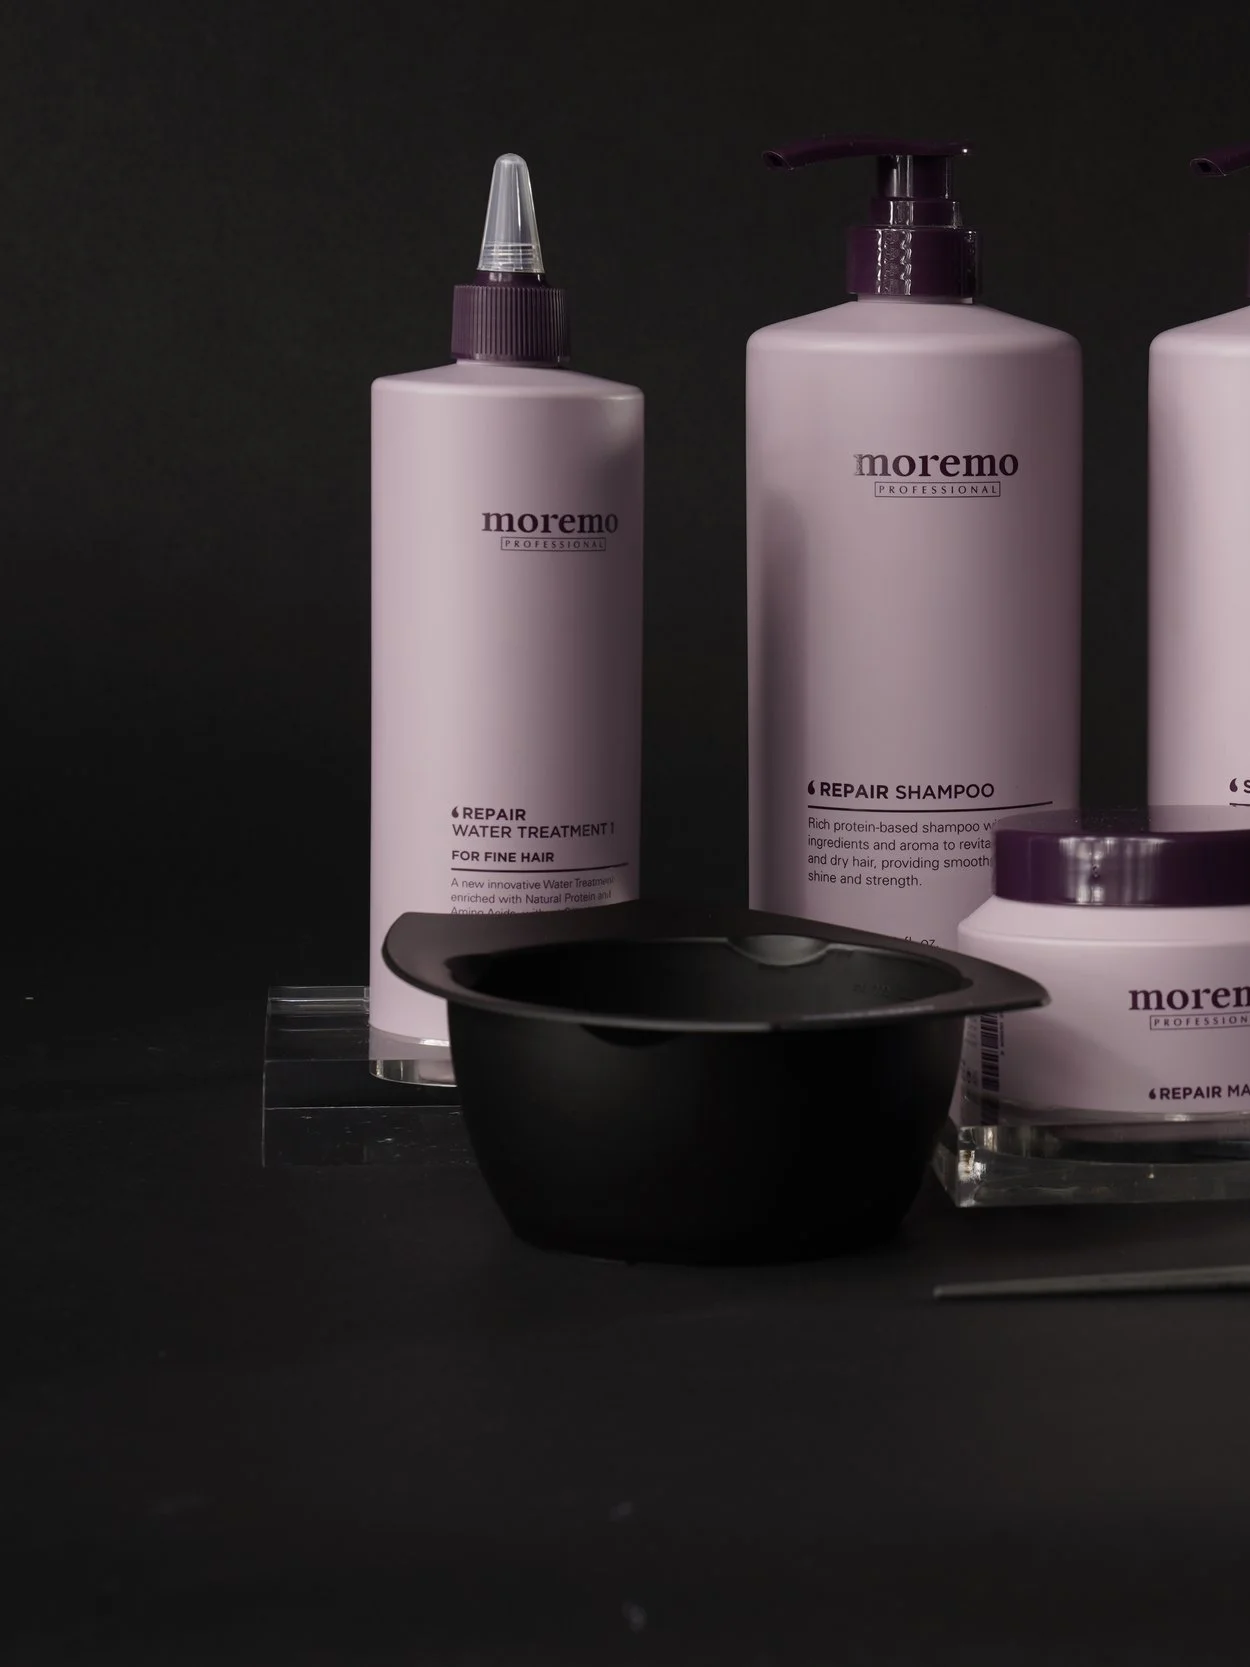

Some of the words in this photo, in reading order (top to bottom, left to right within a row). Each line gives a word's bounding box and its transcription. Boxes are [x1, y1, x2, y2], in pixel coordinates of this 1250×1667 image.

[853, 453, 1018, 477] moremo
[879, 485, 997, 494] PROFESSIONAL
[482, 512, 618, 533] moremo
[506, 540, 603, 548] PROFESSIONAL
[820, 782, 888, 799] REPAIR
[896, 783, 994, 799] SHAMPOO
[463, 807, 526, 821] REPAIR
[452, 824, 511, 838] WATER
[517, 823, 607, 838] TREATMENT
[808, 817, 830, 830] Rich
[834, 820, 918, 834] protein-based
[922, 822, 980, 835] shampoo
[808, 836, 869, 851] ingredients
[874, 840, 895, 850] and
[900, 841, 939, 851] aroma
[943, 840, 955, 850] to
[959, 839, 991, 850] revita
[452, 850, 479, 861] FOR
[484, 852, 516, 862] FINE
[521, 852, 554, 862] HAIR
[808, 854, 826, 865] and
[831, 855, 848, 868] dry
[853, 856, 877, 869] hair,
[881, 856, 939, 870] providing
[943, 856, 991, 868] smooth
[451, 878, 458, 887] A
[488, 879, 540, 889] innovative
[543, 879, 572, 889] Water
[808, 871, 836, 883] shine
[840, 873, 861, 885] and
[866, 874, 922, 888] strength.
[451, 893, 495, 903] enriched
[499, 894, 521, 904] with
[526, 894, 561, 904] Natural
[565, 892, 595, 902] Protein
[1160, 1085, 1221, 1100] REPAIR
